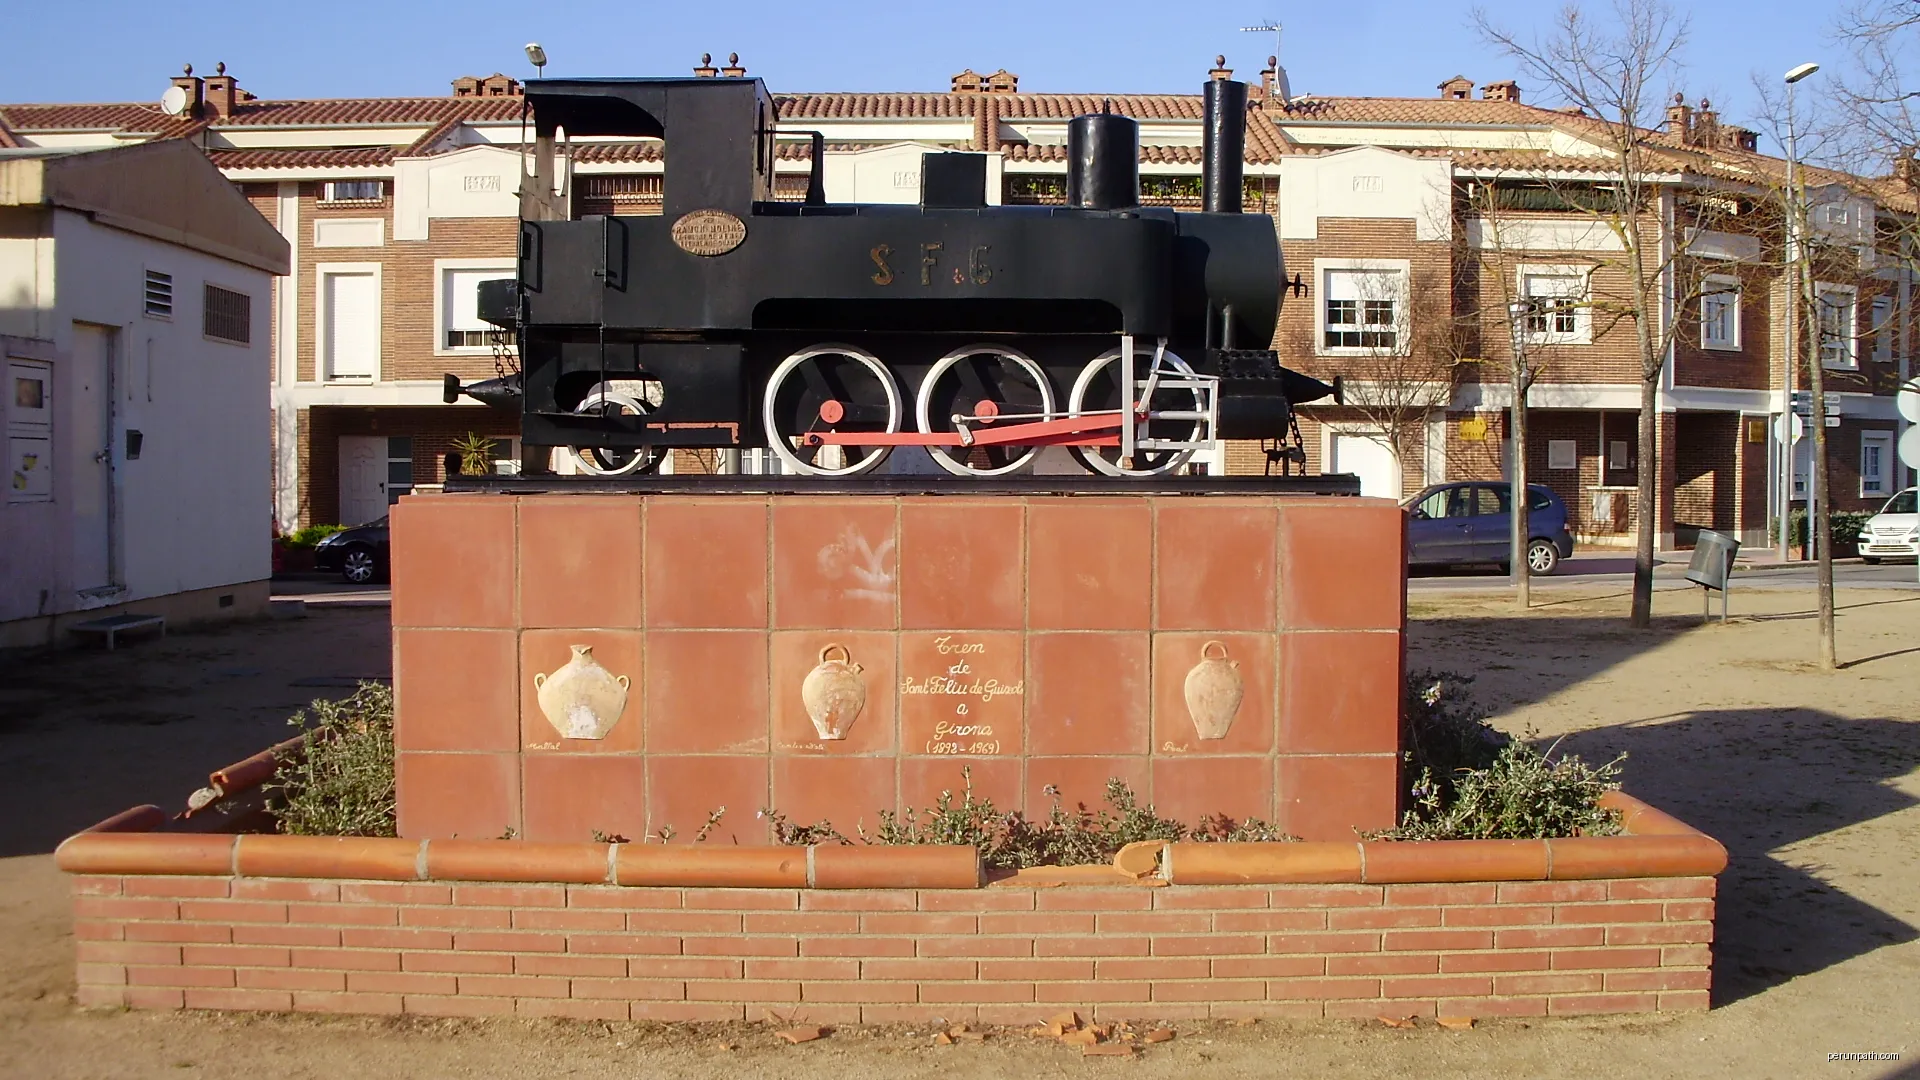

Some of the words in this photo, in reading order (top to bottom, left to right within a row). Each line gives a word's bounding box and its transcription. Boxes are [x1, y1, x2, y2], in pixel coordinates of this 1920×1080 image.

[934, 636, 985, 655] Tren
[950, 659, 971, 674] de
[900, 677, 929, 695] Sant
[930, 675, 968, 695] Feliu
[969, 678, 983, 695] de
[956, 703, 968, 715] a
[934, 721, 993, 740] Girona
